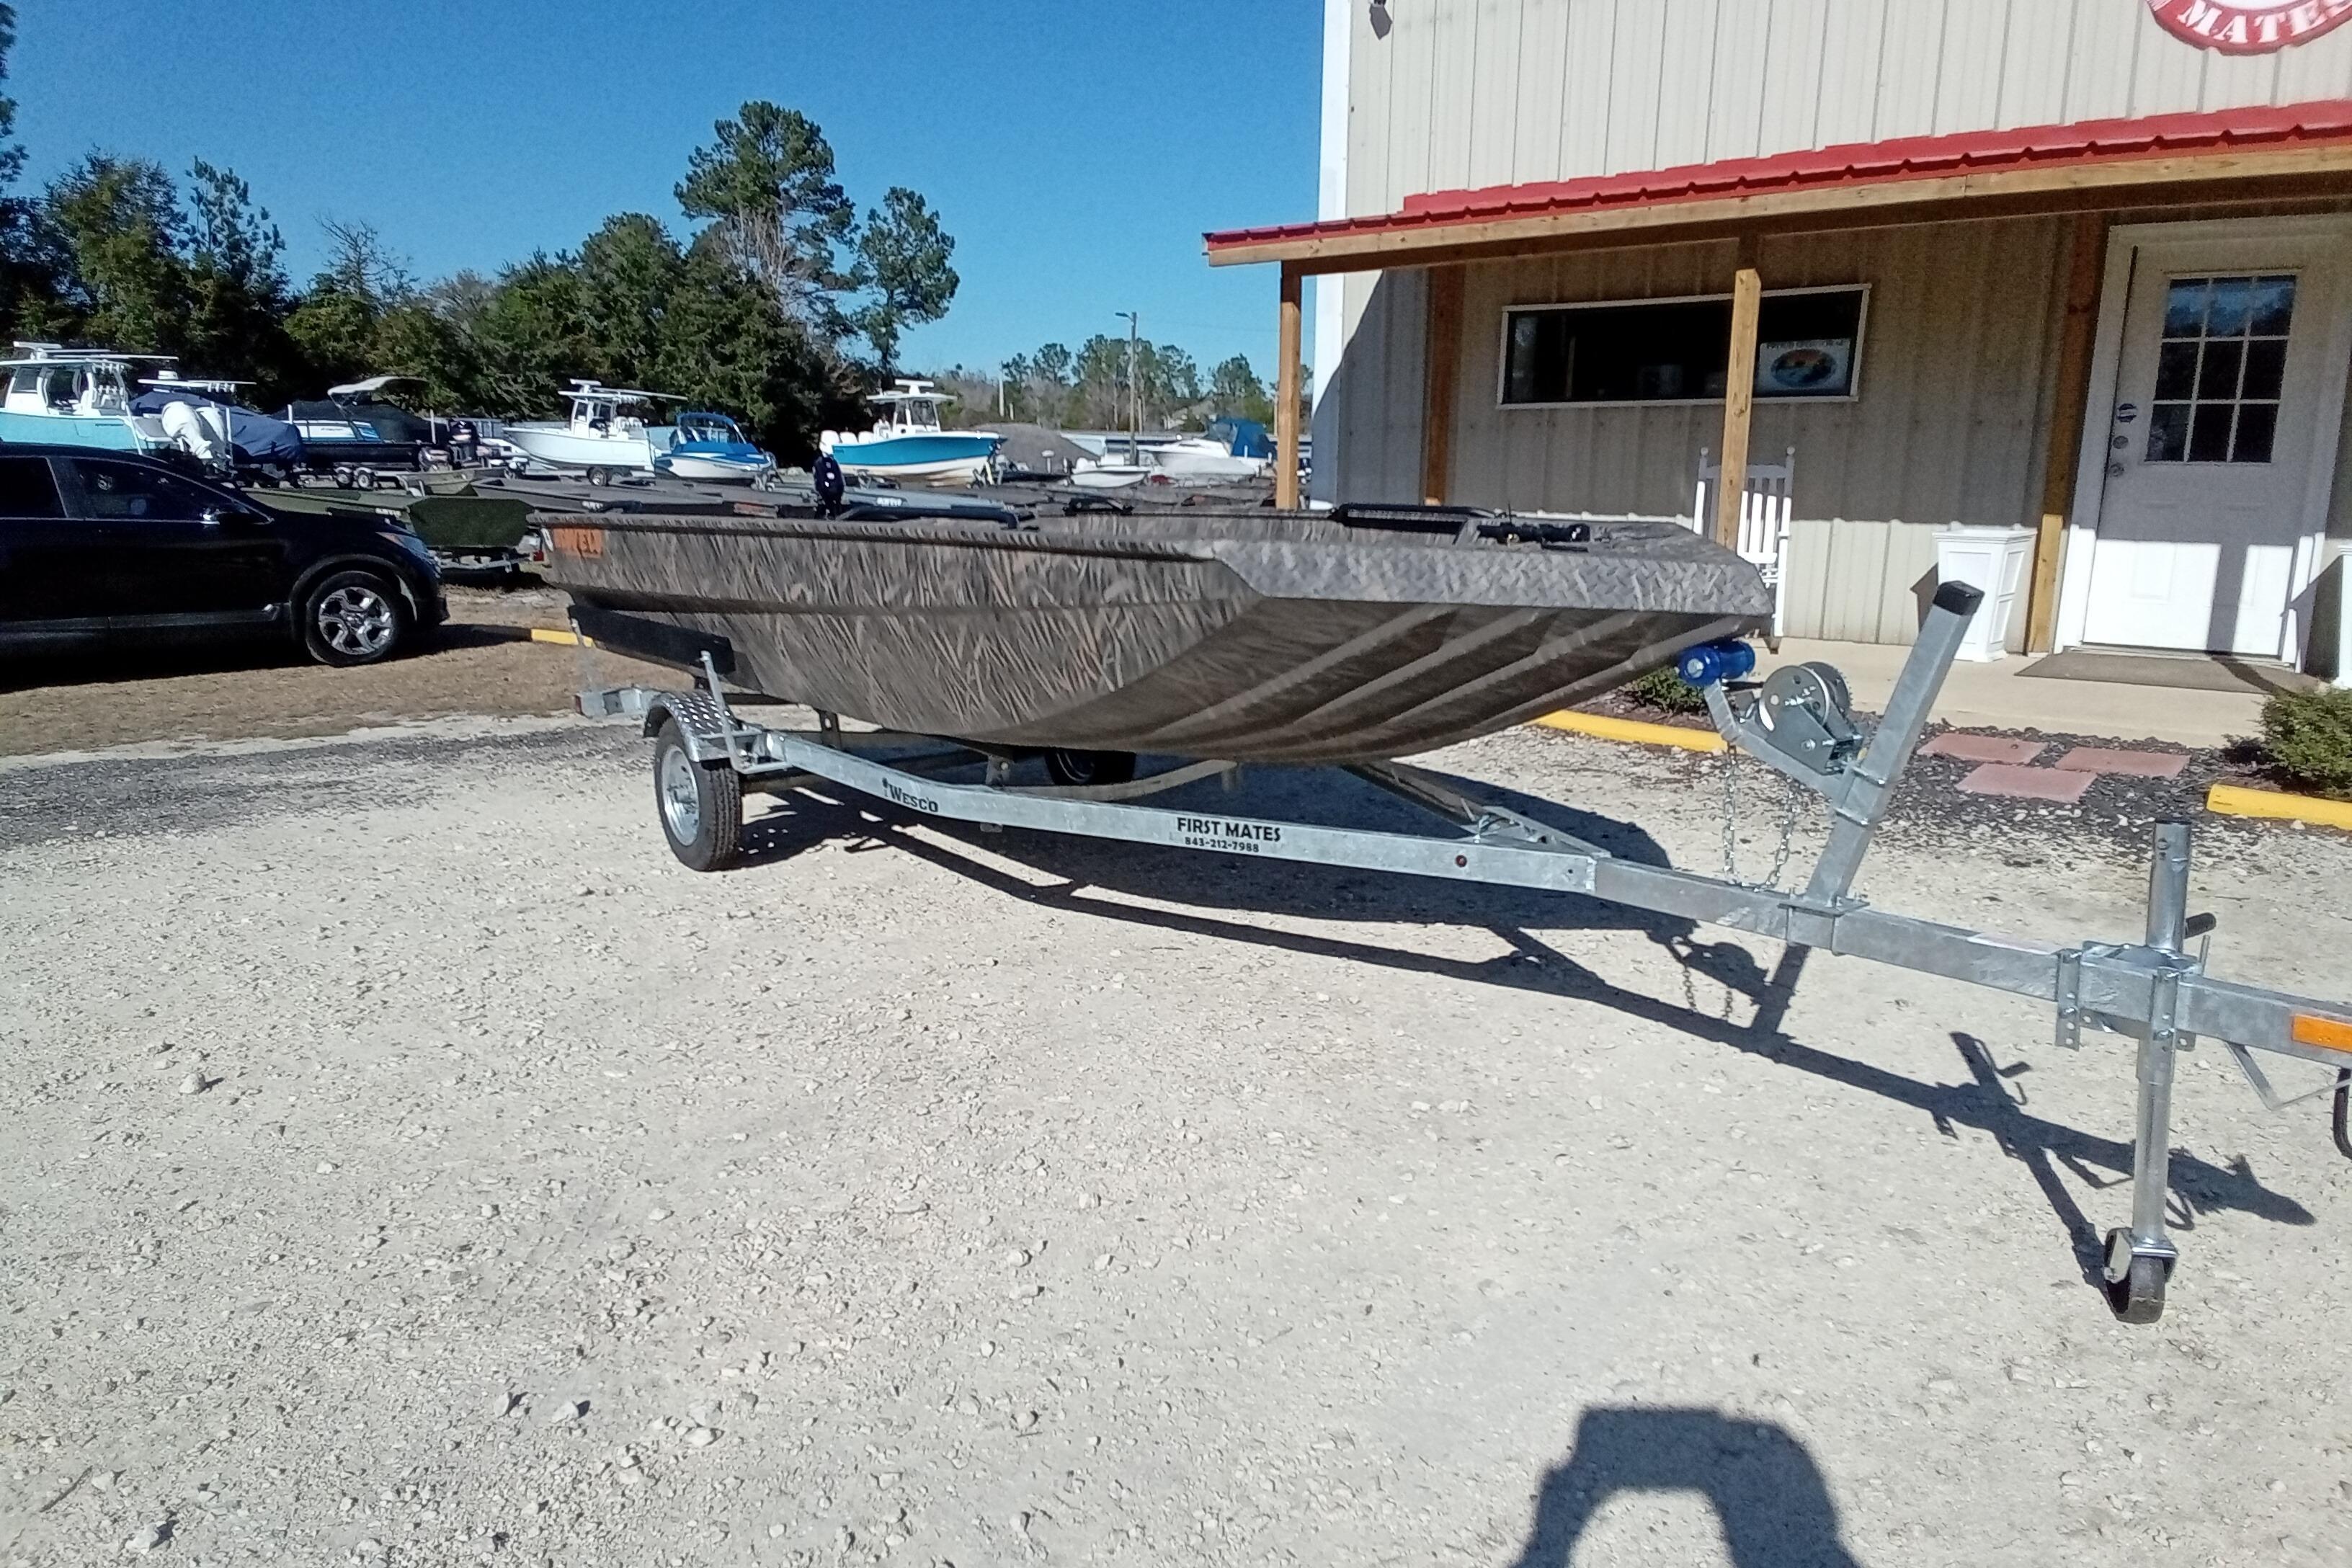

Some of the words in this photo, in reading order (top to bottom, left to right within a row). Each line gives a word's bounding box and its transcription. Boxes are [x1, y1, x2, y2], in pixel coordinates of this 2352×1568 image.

[1177, 817, 1221, 835] FIRST
[1225, 822, 1280, 842] MATES
[1185, 837, 1260, 852] 843-212-7988
